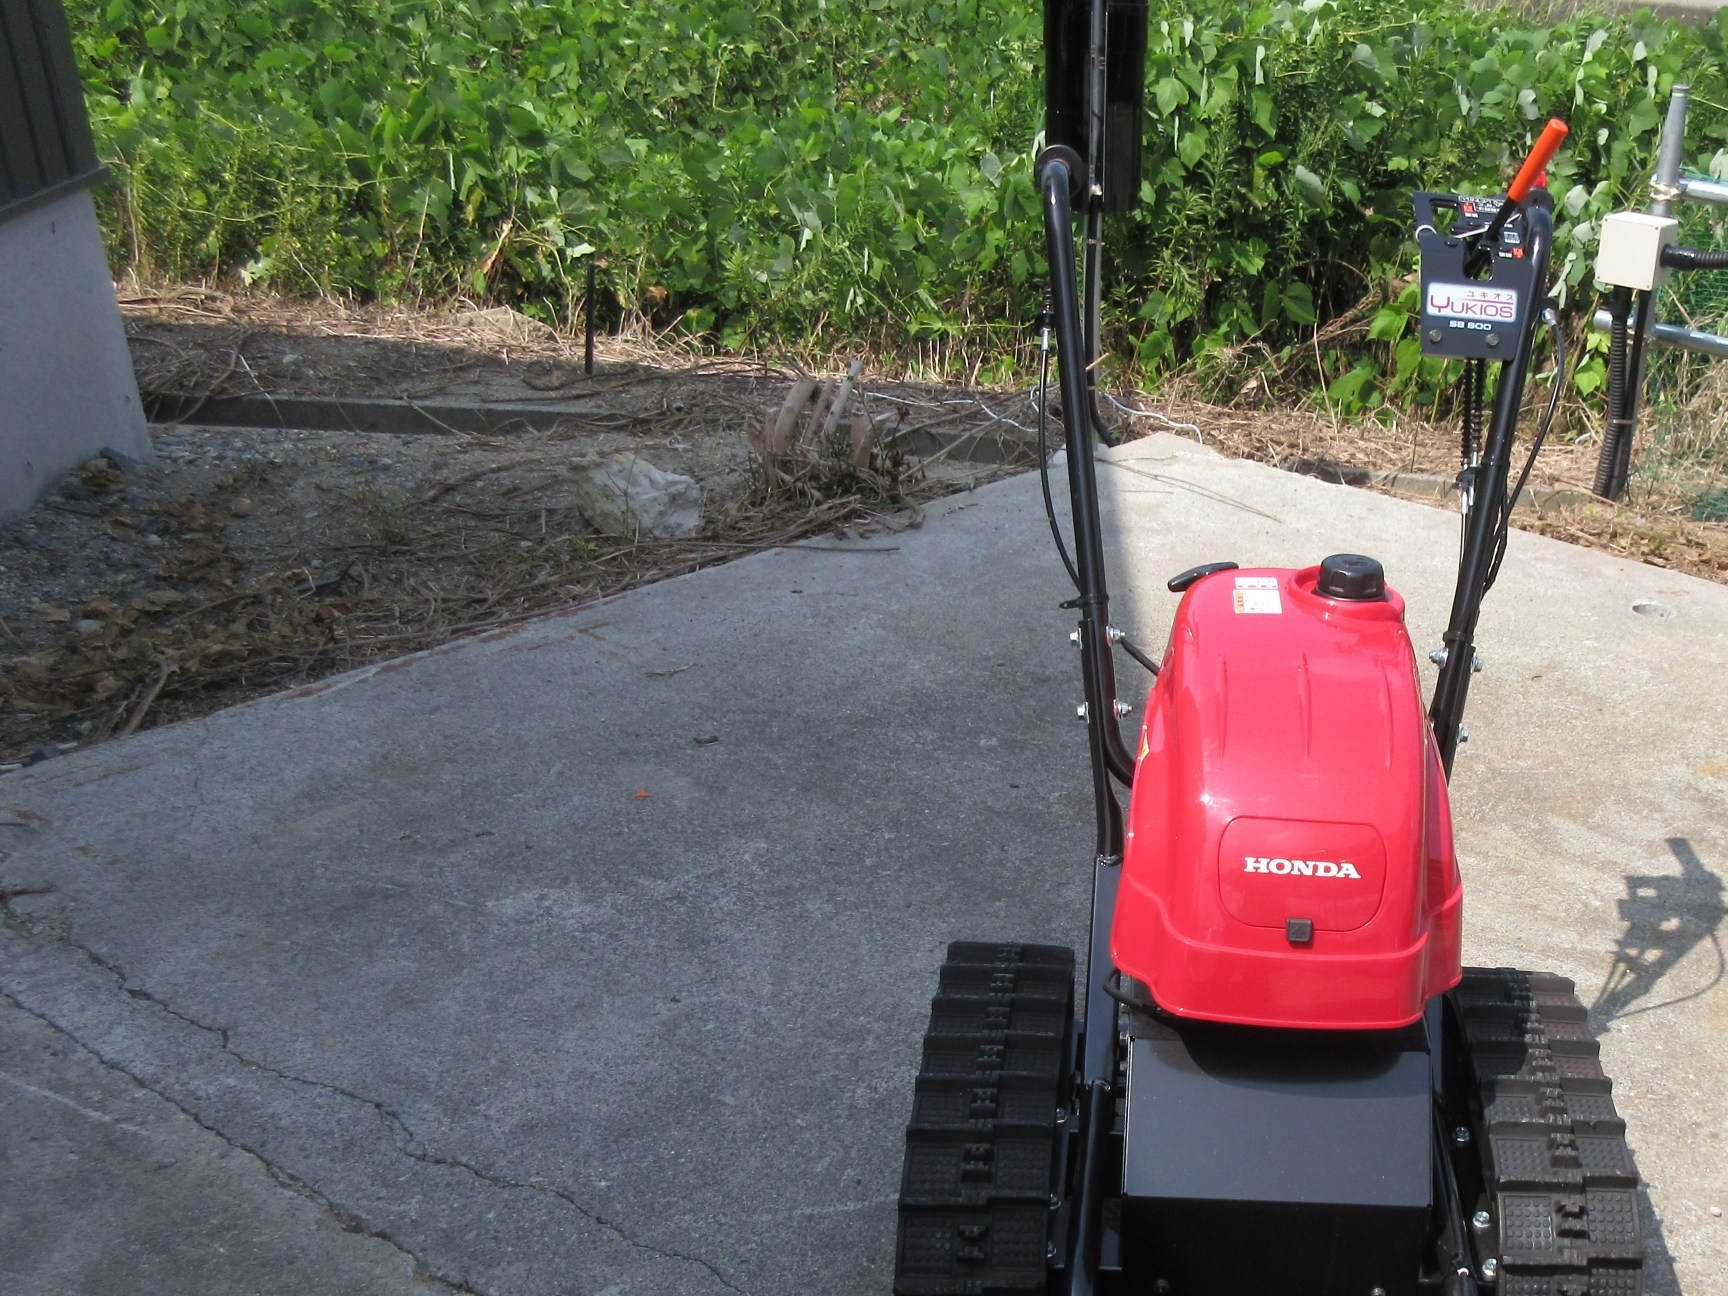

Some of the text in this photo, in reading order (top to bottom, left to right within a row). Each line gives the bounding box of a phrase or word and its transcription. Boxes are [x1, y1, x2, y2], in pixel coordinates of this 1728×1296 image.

[1430, 294, 1513, 319] YUKIOS
[1449, 320, 1492, 331] SB 800
[1243, 856, 1362, 879] HONDA
